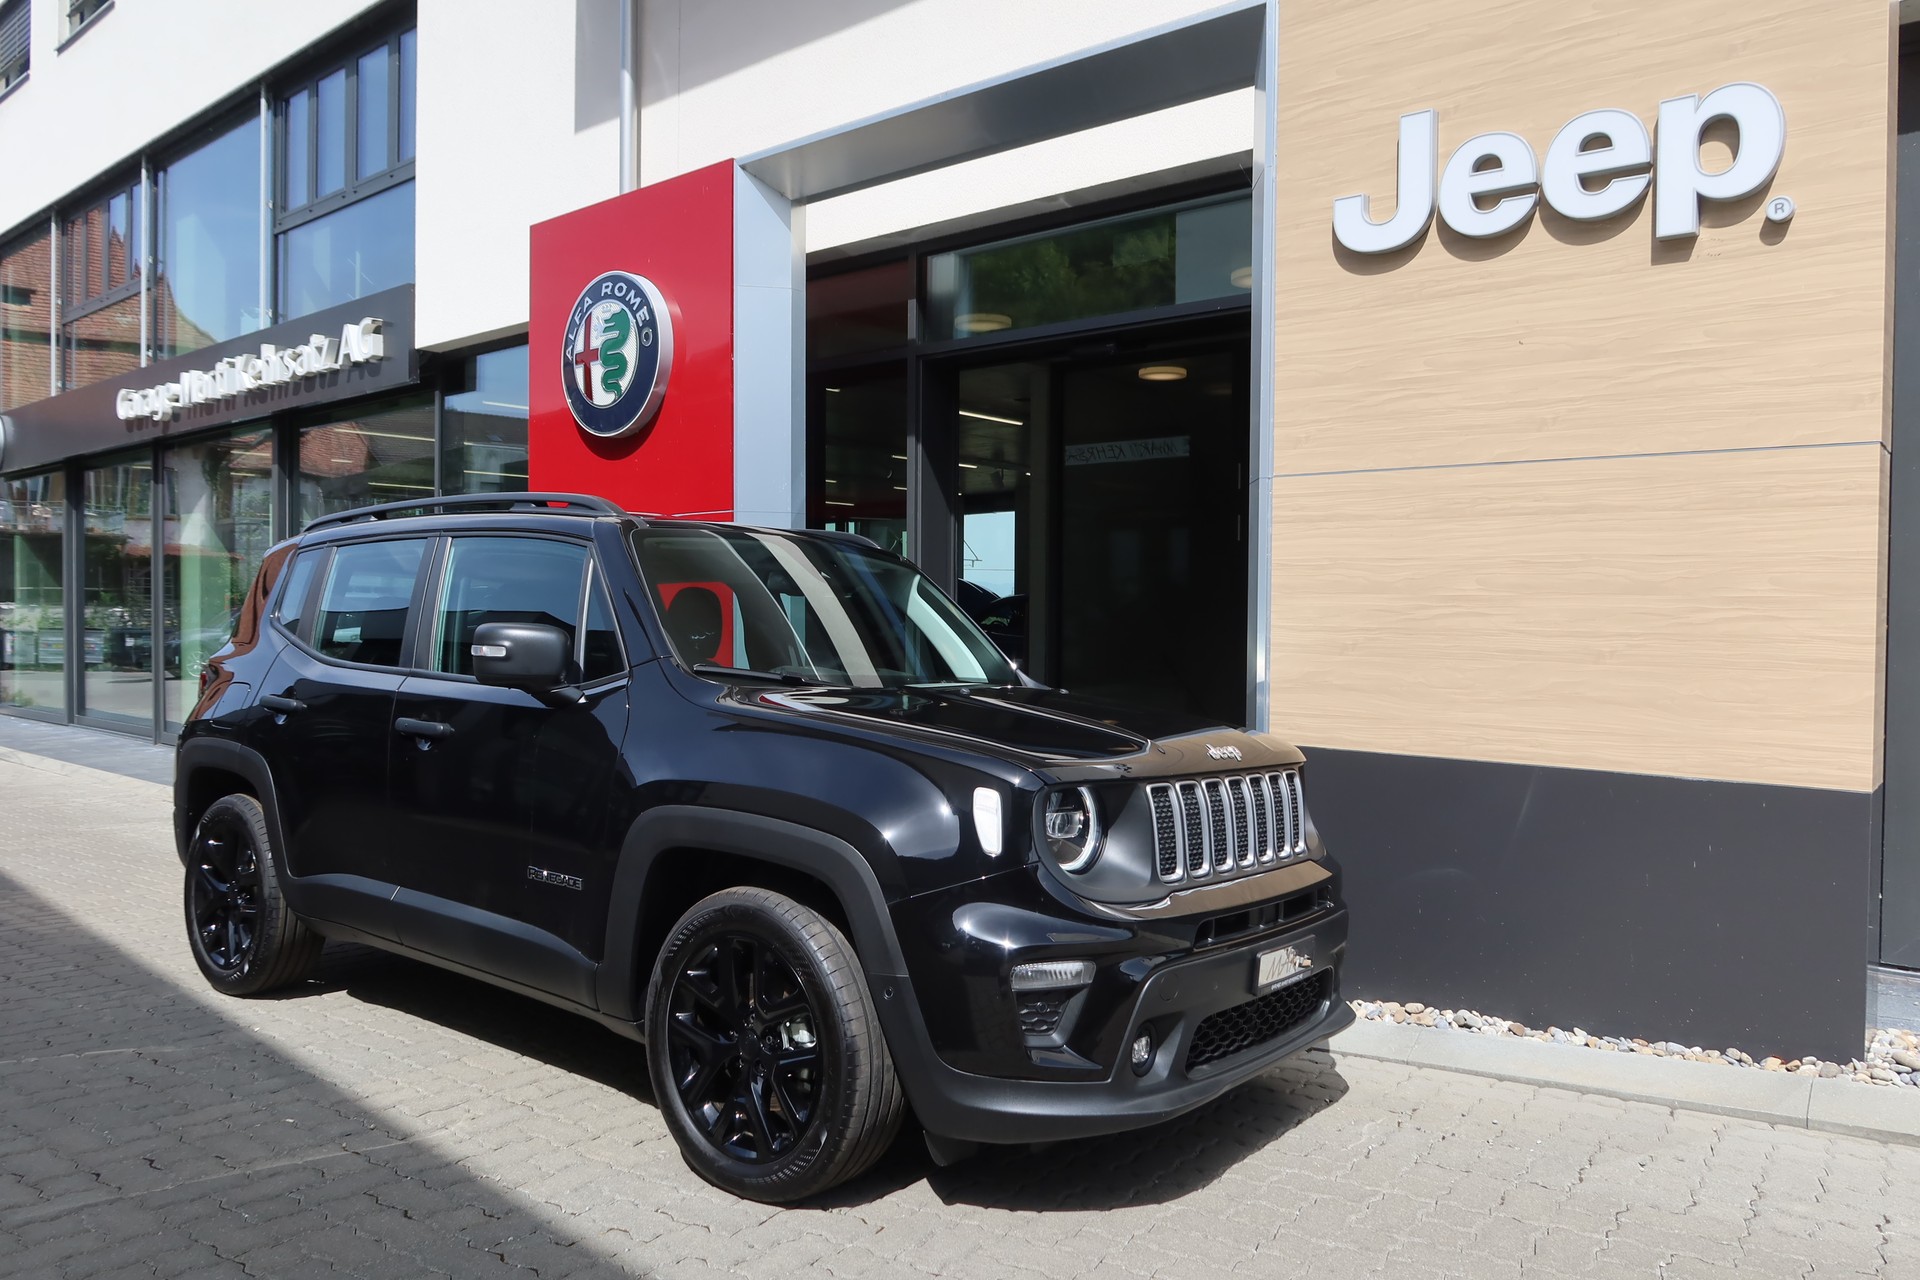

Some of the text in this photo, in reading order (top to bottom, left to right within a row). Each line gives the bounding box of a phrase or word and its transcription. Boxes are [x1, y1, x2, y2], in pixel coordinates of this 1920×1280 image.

[1332, 81, 1786, 254] Jeep
[565, 281, 653, 361] ALFA ROMEO
[116, 382, 182, 421] Garage
[338, 316, 385, 363] AG
[1205, 743, 1243, 762] Jeep
